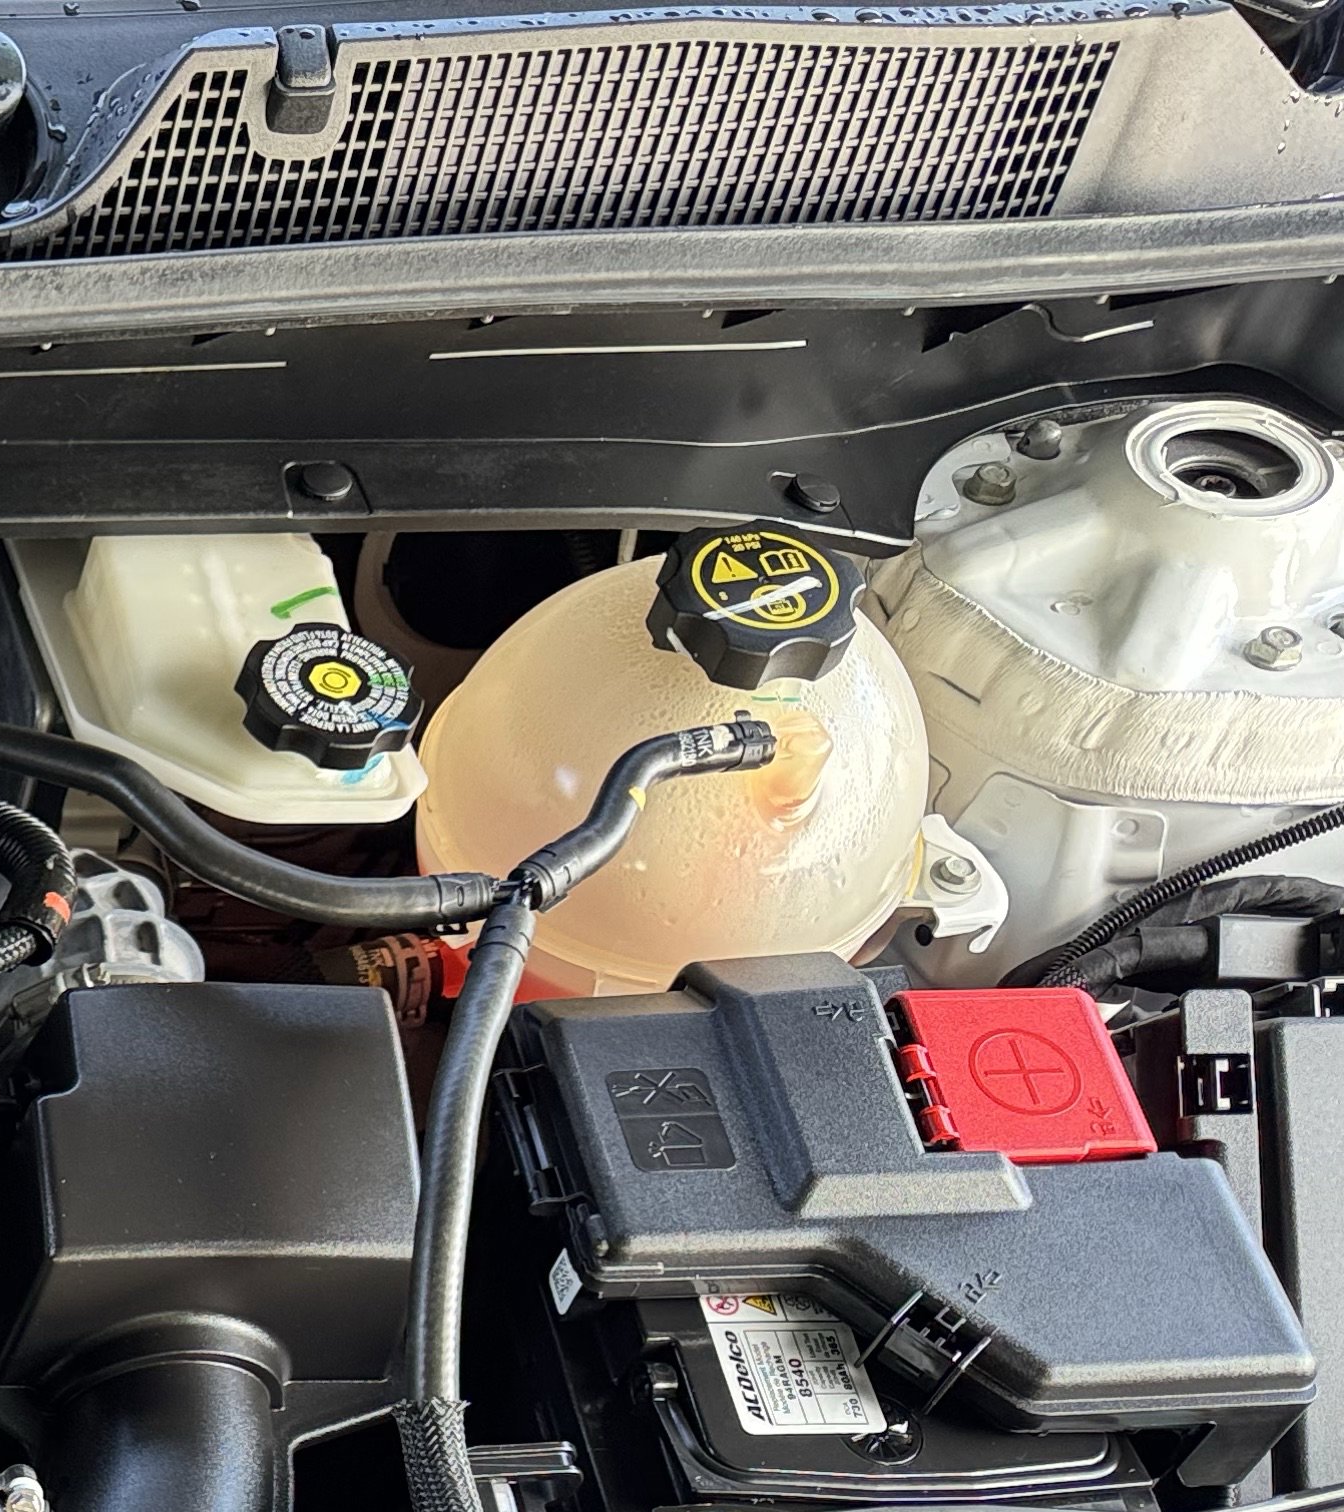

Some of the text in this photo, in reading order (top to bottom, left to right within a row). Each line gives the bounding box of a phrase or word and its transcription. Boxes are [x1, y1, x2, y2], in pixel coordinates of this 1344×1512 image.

[693, 729, 713, 757] TNK
[725, 1331, 764, 1419] ACDelco
[788, 1358, 812, 1396] 8540
[835, 1363, 852, 1389] 80Ah
[848, 1398, 862, 1417] 730
